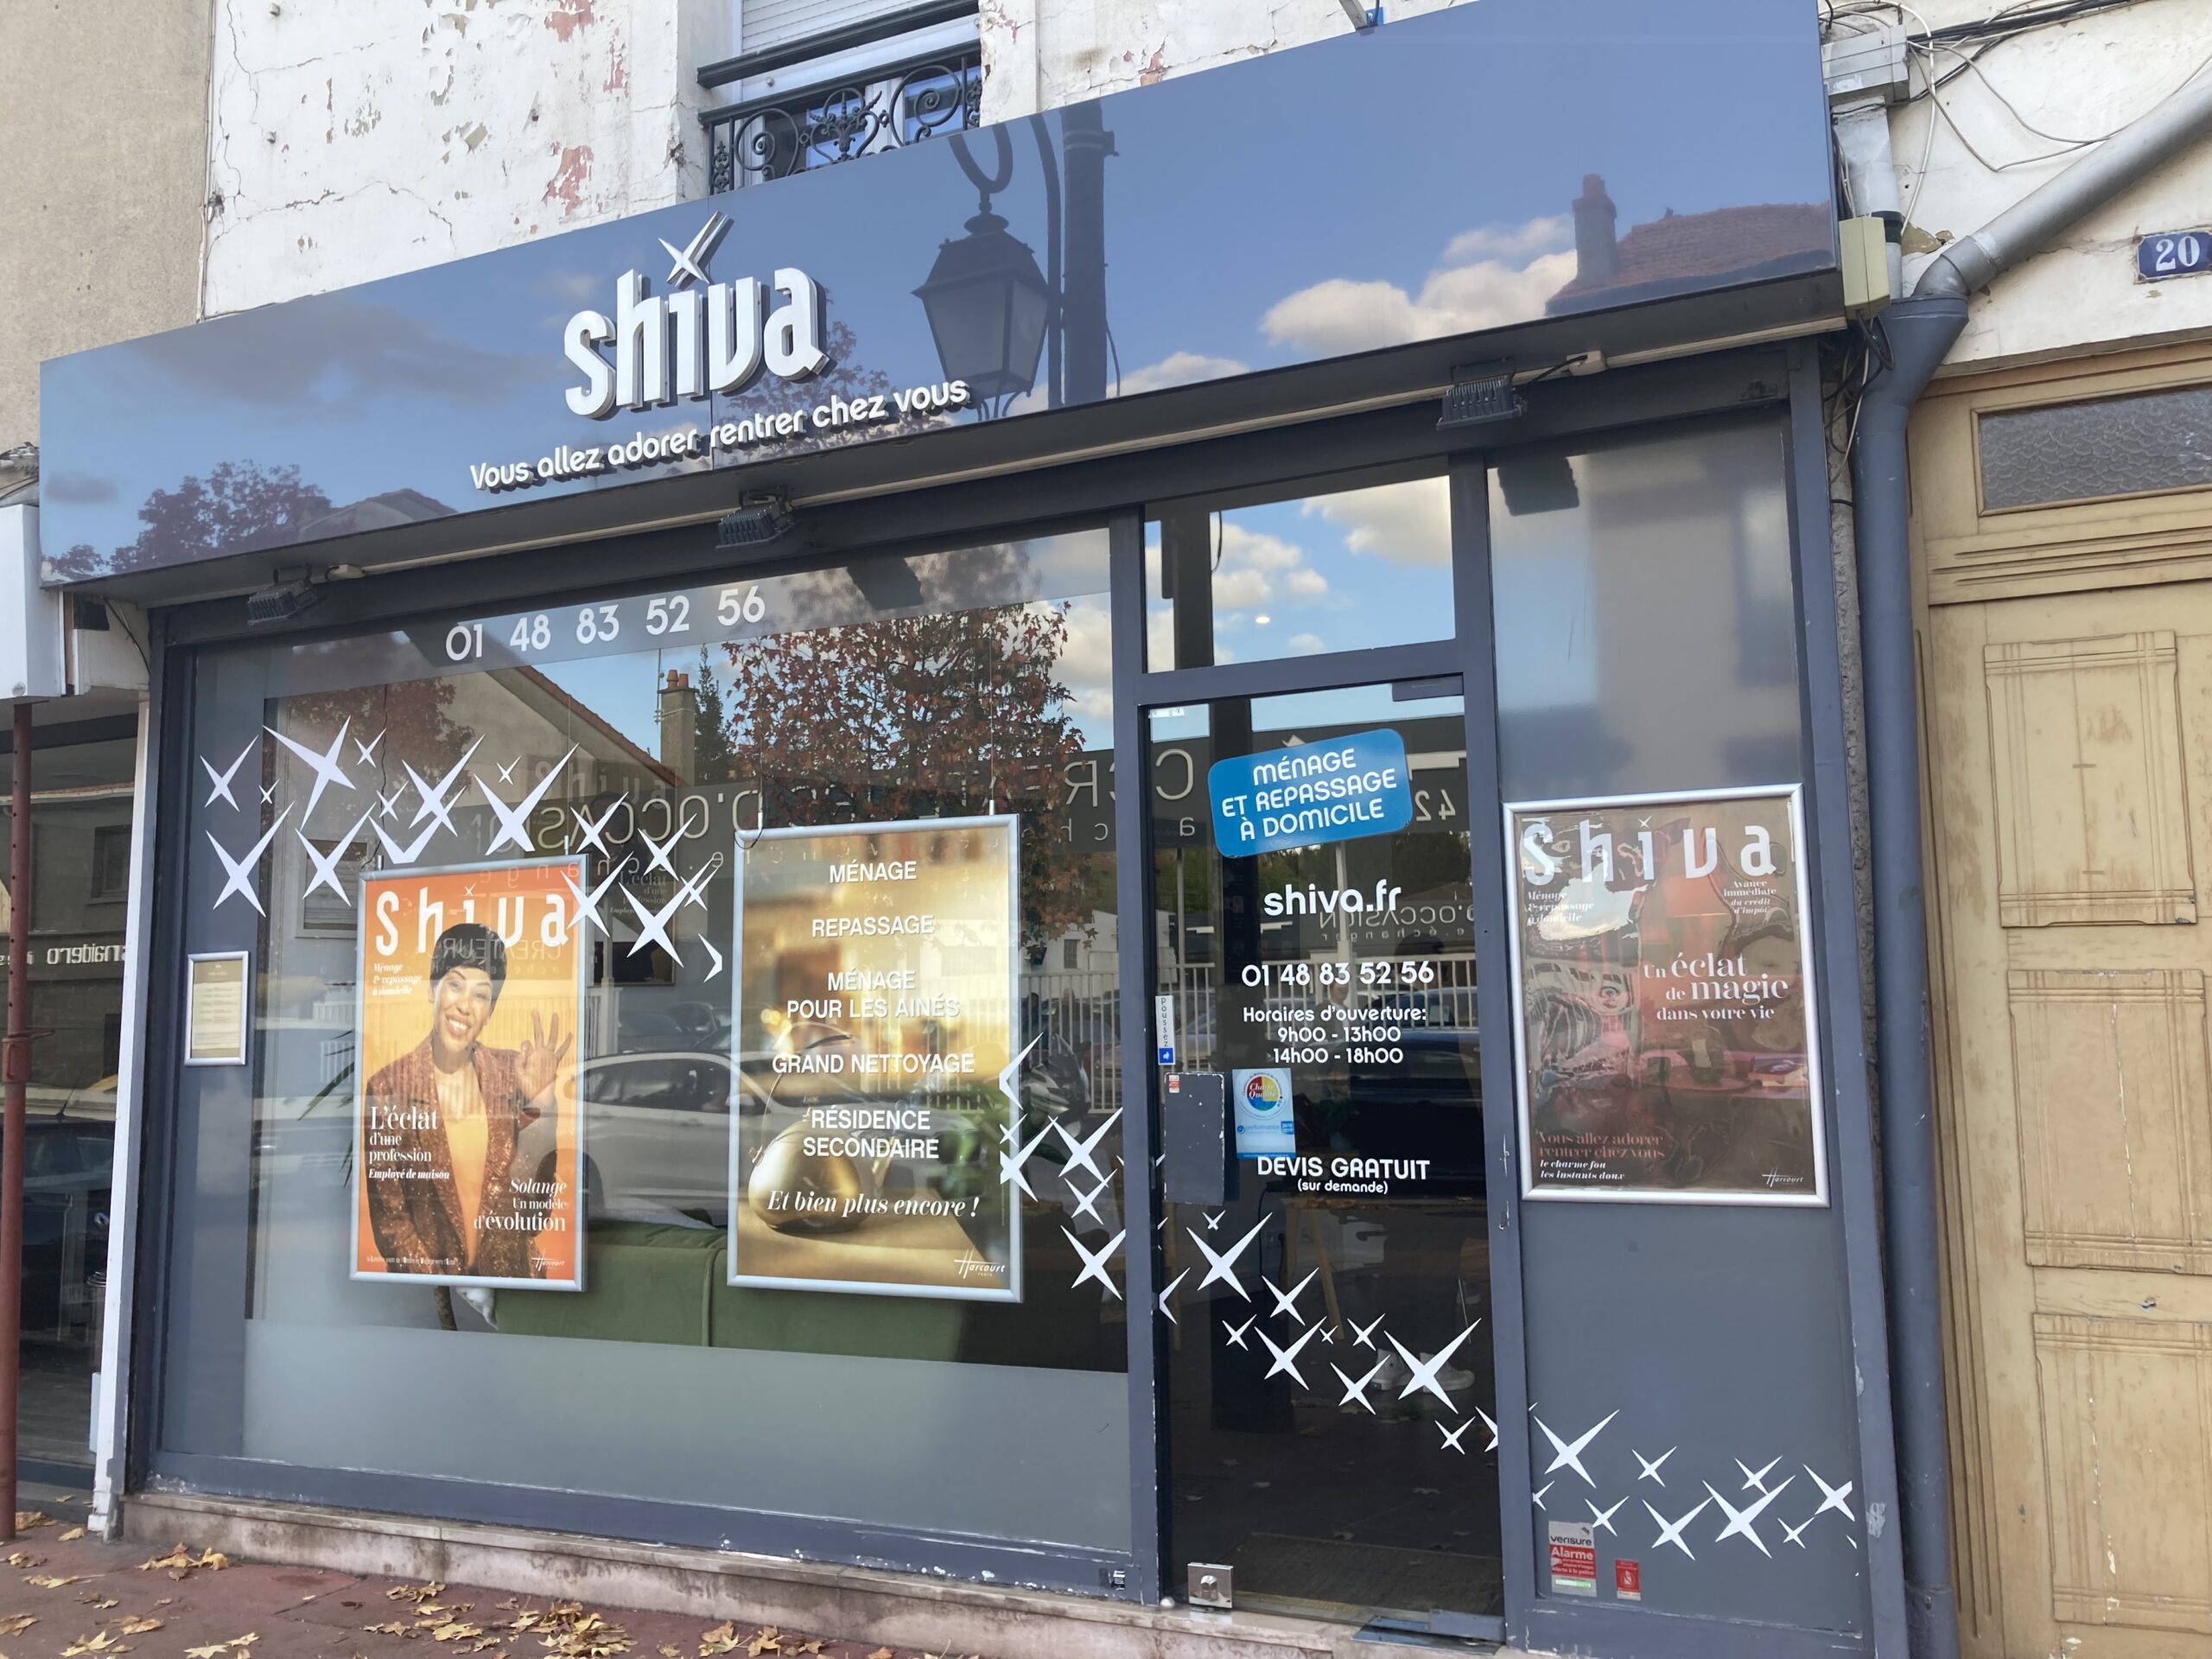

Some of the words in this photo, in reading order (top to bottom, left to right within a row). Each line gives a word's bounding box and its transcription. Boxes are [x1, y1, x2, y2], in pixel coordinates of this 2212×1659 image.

[2156, 236, 2200, 271] 20
[564, 213, 830, 419] shiva
[470, 461, 531, 490] Vous
[537, 444, 602, 478] allez
[607, 429, 700, 467] adorer
[710, 408, 807, 448] rentrer
[812, 394, 896, 429] chez
[893, 380, 969, 412] vous
[446, 623, 483, 661] 01
[510, 614, 551, 652] 48
[576, 604, 620, 645] 83
[646, 594, 690, 635] 52
[717, 585, 766, 626] 56
[1253, 748, 1356, 786] MÉNAGE
[1222, 795, 1248, 817] ET
[1255, 768, 1397, 812] REPASSAGE
[1240, 817, 1255, 841] À
[1263, 798, 1384, 837] DOMICILE
[830, 859, 917, 883] MÉNAGE
[1264, 879, 1402, 916] shiva.fr
[1528, 891, 1567, 901] Ménage
[1724, 887, 1777, 897] immédiate
[812, 915, 934, 938] REPASSAGE
[1242, 964, 1269, 987] 01
[1280, 963, 1311, 985] 48
[1319, 963, 1351, 985] 83
[1359, 962, 1391, 984] 52
[1401, 961, 1434, 984] 56
[1643, 965, 1666, 978] Un
[1671, 952, 1747, 978] éclat
[828, 968, 916, 991] MÉNAGE
[1666, 988, 1686, 1001] de
[1691, 974, 1789, 1004] magie
[787, 999, 842, 1019] POUR
[849, 999, 887, 1018] LES
[895, 994, 960, 1018] AINÉS
[1243, 1007, 1314, 1022] Horaires
[1320, 1005, 1427, 1021] d'ouverture:
[1656, 1007, 1697, 1020] dans
[1701, 1008, 1745, 1020] votre
[1750, 1005, 1775, 1019] vie
[1277, 1027, 1325, 1042] 9h00
[1344, 1027, 1402, 1042] 13h00
[772, 1055, 844, 1073] GRAND
[851, 1053, 975, 1073] NETTOYAGE
[1274, 1048, 1328, 1064] 14h00
[1346, 1047, 1403, 1064] 18h00
[371, 1105, 438, 1130] L'éclat
[811, 1105, 931, 1130] RÉSIDENCE
[369, 1132, 403, 1146] d'une
[803, 1137, 939, 1159] SECONDAIRE
[1539, 1132, 1573, 1145] Vous
[1577, 1132, 1609, 1145] allez
[1612, 1133, 1663, 1146] adorer
[369, 1148, 432, 1165] profession
[1540, 1147, 1592, 1158] rentrer
[1594, 1147, 1628, 1158] chez
[1630, 1148, 1665, 1159] vous
[369, 1168, 405, 1181] Employé
[405, 1168, 416, 1179] de
[417, 1169, 450, 1179] maison
[1257, 1157, 1323, 1176] DEVIS
[1331, 1159, 1430, 1180] GRATUIT
[1541, 1170, 1554, 1179] les
[1556, 1170, 1597, 1179] instants
[1599, 1171, 1625, 1179] doux
[1550, 1160, 1588, 1168] charme
[1588, 1160, 1606, 1170] fou
[1762, 1166, 1803, 1187] Harcourt
[510, 1178, 567, 1198] Solange
[1298, 1180, 1320, 1192] (sur
[1325, 1180, 1389, 1195] demande)
[513, 1198, 527, 1209] Un
[529, 1198, 567, 1210] modèle
[767, 1190, 789, 1211] Et
[795, 1191, 837, 1212] bien
[842, 1193, 887, 1217] plus
[894, 1199, 966, 1217] encore
[474, 1210, 566, 1231] d'évolution
[953, 1245, 1006, 1279] Harcourt
[1550, 1535, 1592, 1546] verisure
[1551, 1546, 1593, 1560] Alarme
